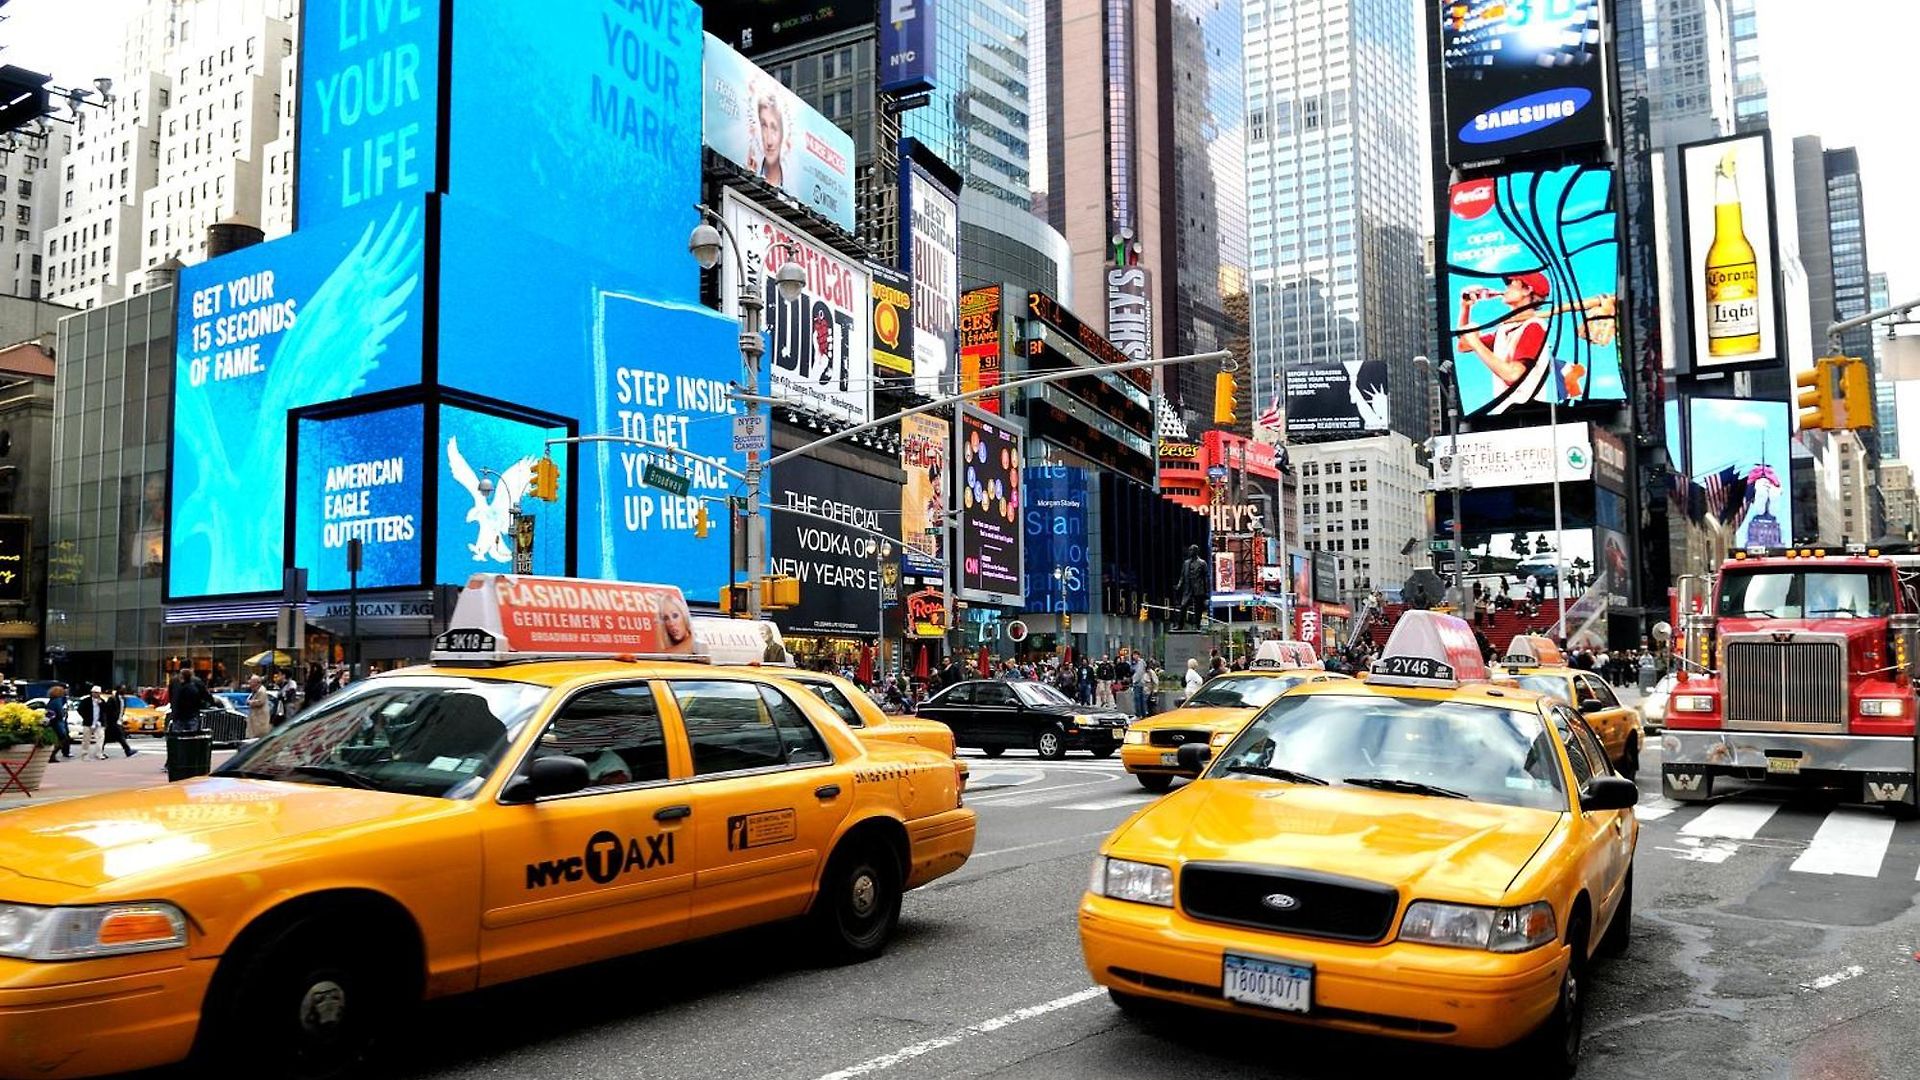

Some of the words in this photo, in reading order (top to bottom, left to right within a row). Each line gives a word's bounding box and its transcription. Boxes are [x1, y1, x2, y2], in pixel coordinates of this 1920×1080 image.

[603, 12, 681, 109] YOUR
[890, 51, 916, 66] NYC
[315, 43, 420, 135] YOUR
[591, 73, 682, 172] MARK
[1475, 100, 1576, 131] SAMSUNG
[342, 123, 419, 207] LIFE
[924, 198, 946, 229] BEST
[912, 209, 956, 255] MUSICAL
[915, 235, 945, 290] BILLY
[1708, 269, 1756, 287] Corona
[193, 284, 224, 319] GET
[227, 270, 275, 309] YOUR
[192, 322, 212, 353] 15
[215, 298, 297, 347] SECONDS
[874, 301, 900, 350] Q
[1714, 303, 1754, 323] Light
[766, 276, 855, 392] IDIOT
[190, 355, 212, 387] OF
[214, 343, 266, 381] FAME.
[616, 367, 670, 407] STEP
[675, 376, 738, 414] INSIDE
[618, 410, 647, 448] TO
[652, 413, 690, 449] GET
[738, 417, 762, 425] NYPD
[324, 457, 404, 493] AMERICAN
[620, 452, 678, 489] YO
[683, 456, 729, 489] FACE
[650, 470, 683, 494] Broadway
[323, 490, 371, 520] EAGLE
[623, 495, 654, 532] UP
[784, 490, 818, 515] THE
[820, 498, 884, 532] OFFICIAL
[323, 514, 415, 549] OUTFITTERS
[796, 525, 851, 558] VODKA
[771, 557, 810, 583] NEW
[812, 563, 866, 589] YEAR'S
[325, 603, 396, 617] AMERICAN
[495, 582, 660, 613] FLASHDANCERS
[513, 610, 614, 630] GENTLEMEN'S
[617, 615, 652, 632] CLUB
[530, 632, 578, 643] BROADWAY
[580, 632, 592, 643] AT
[613, 634, 641, 645] STREET
[1301, 611, 1318, 641] tkts
[450, 633, 480, 650] 3K18
[1392, 657, 1429, 675] 2Y46
[526, 859, 584, 889] NYC
[587, 829, 676, 882] TAXI
